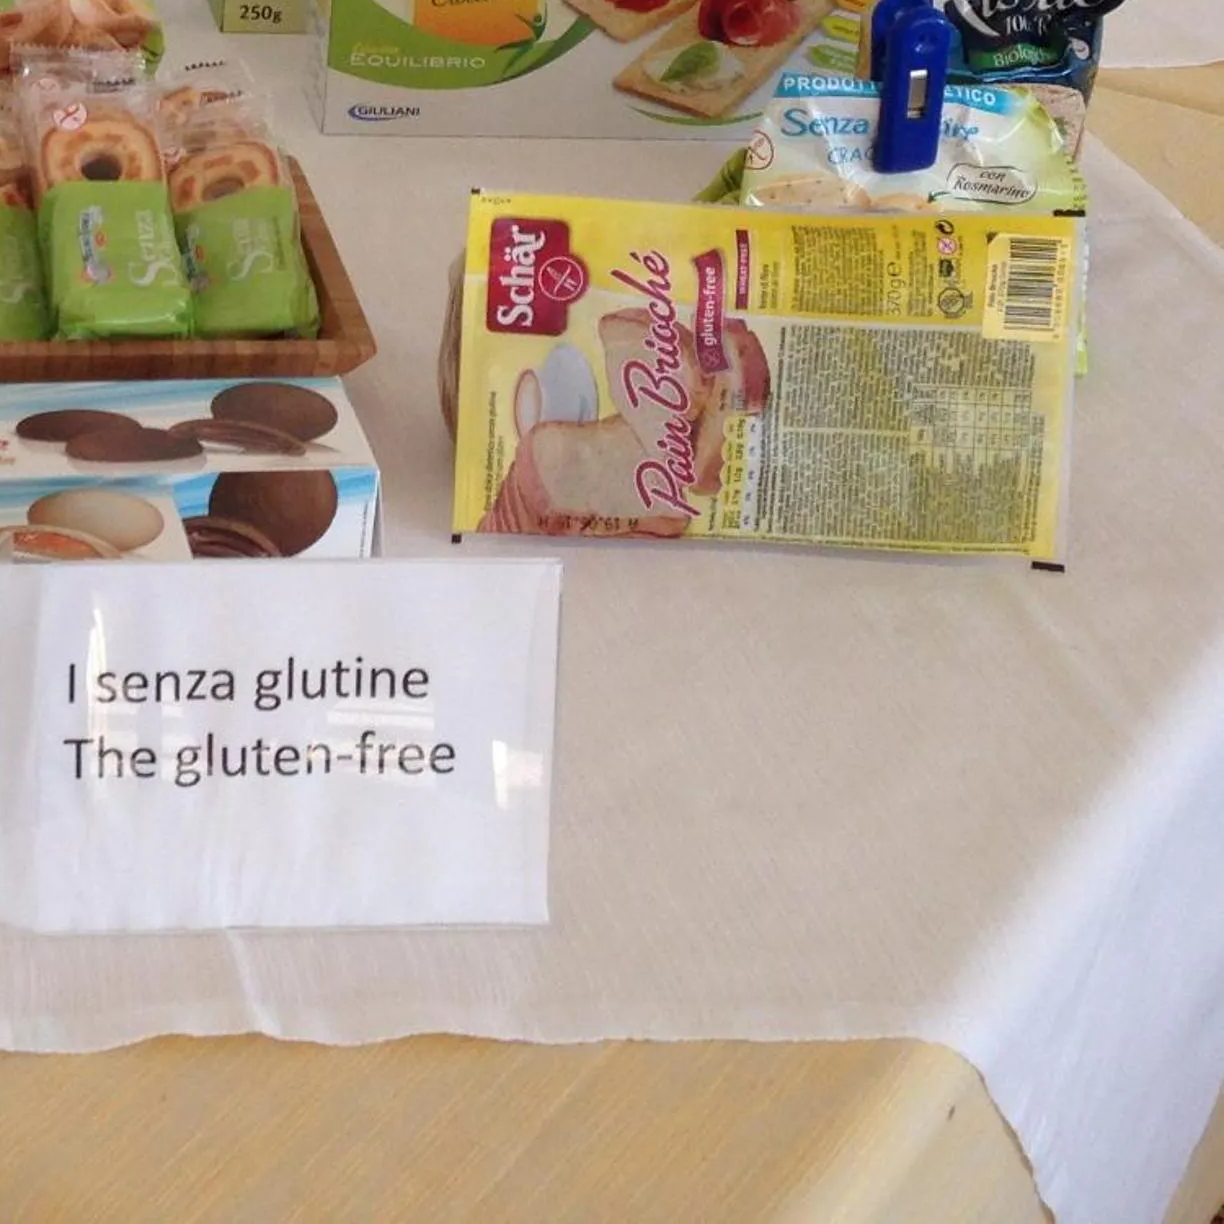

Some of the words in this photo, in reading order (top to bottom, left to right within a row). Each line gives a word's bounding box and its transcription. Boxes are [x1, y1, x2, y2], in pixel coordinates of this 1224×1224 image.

[238, 4, 283, 24] 250g
[349, 52, 487, 69] EQUILIBRIO
[356, 106, 421, 117] GIULIANI
[779, 107, 870, 137] Senza
[952, 175, 1031, 199] Rosmarino
[979, 169, 1006, 181] con
[496, 224, 546, 327] Schär
[701, 266, 719, 347] gluten-free
[635, 417, 701, 517] Pain
[67, 662, 76, 704] I
[94, 668, 236, 704] senza
[253, 656, 430, 712] glutine
[63, 735, 157, 781] The
[175, 730, 457, 788] gluten-free
